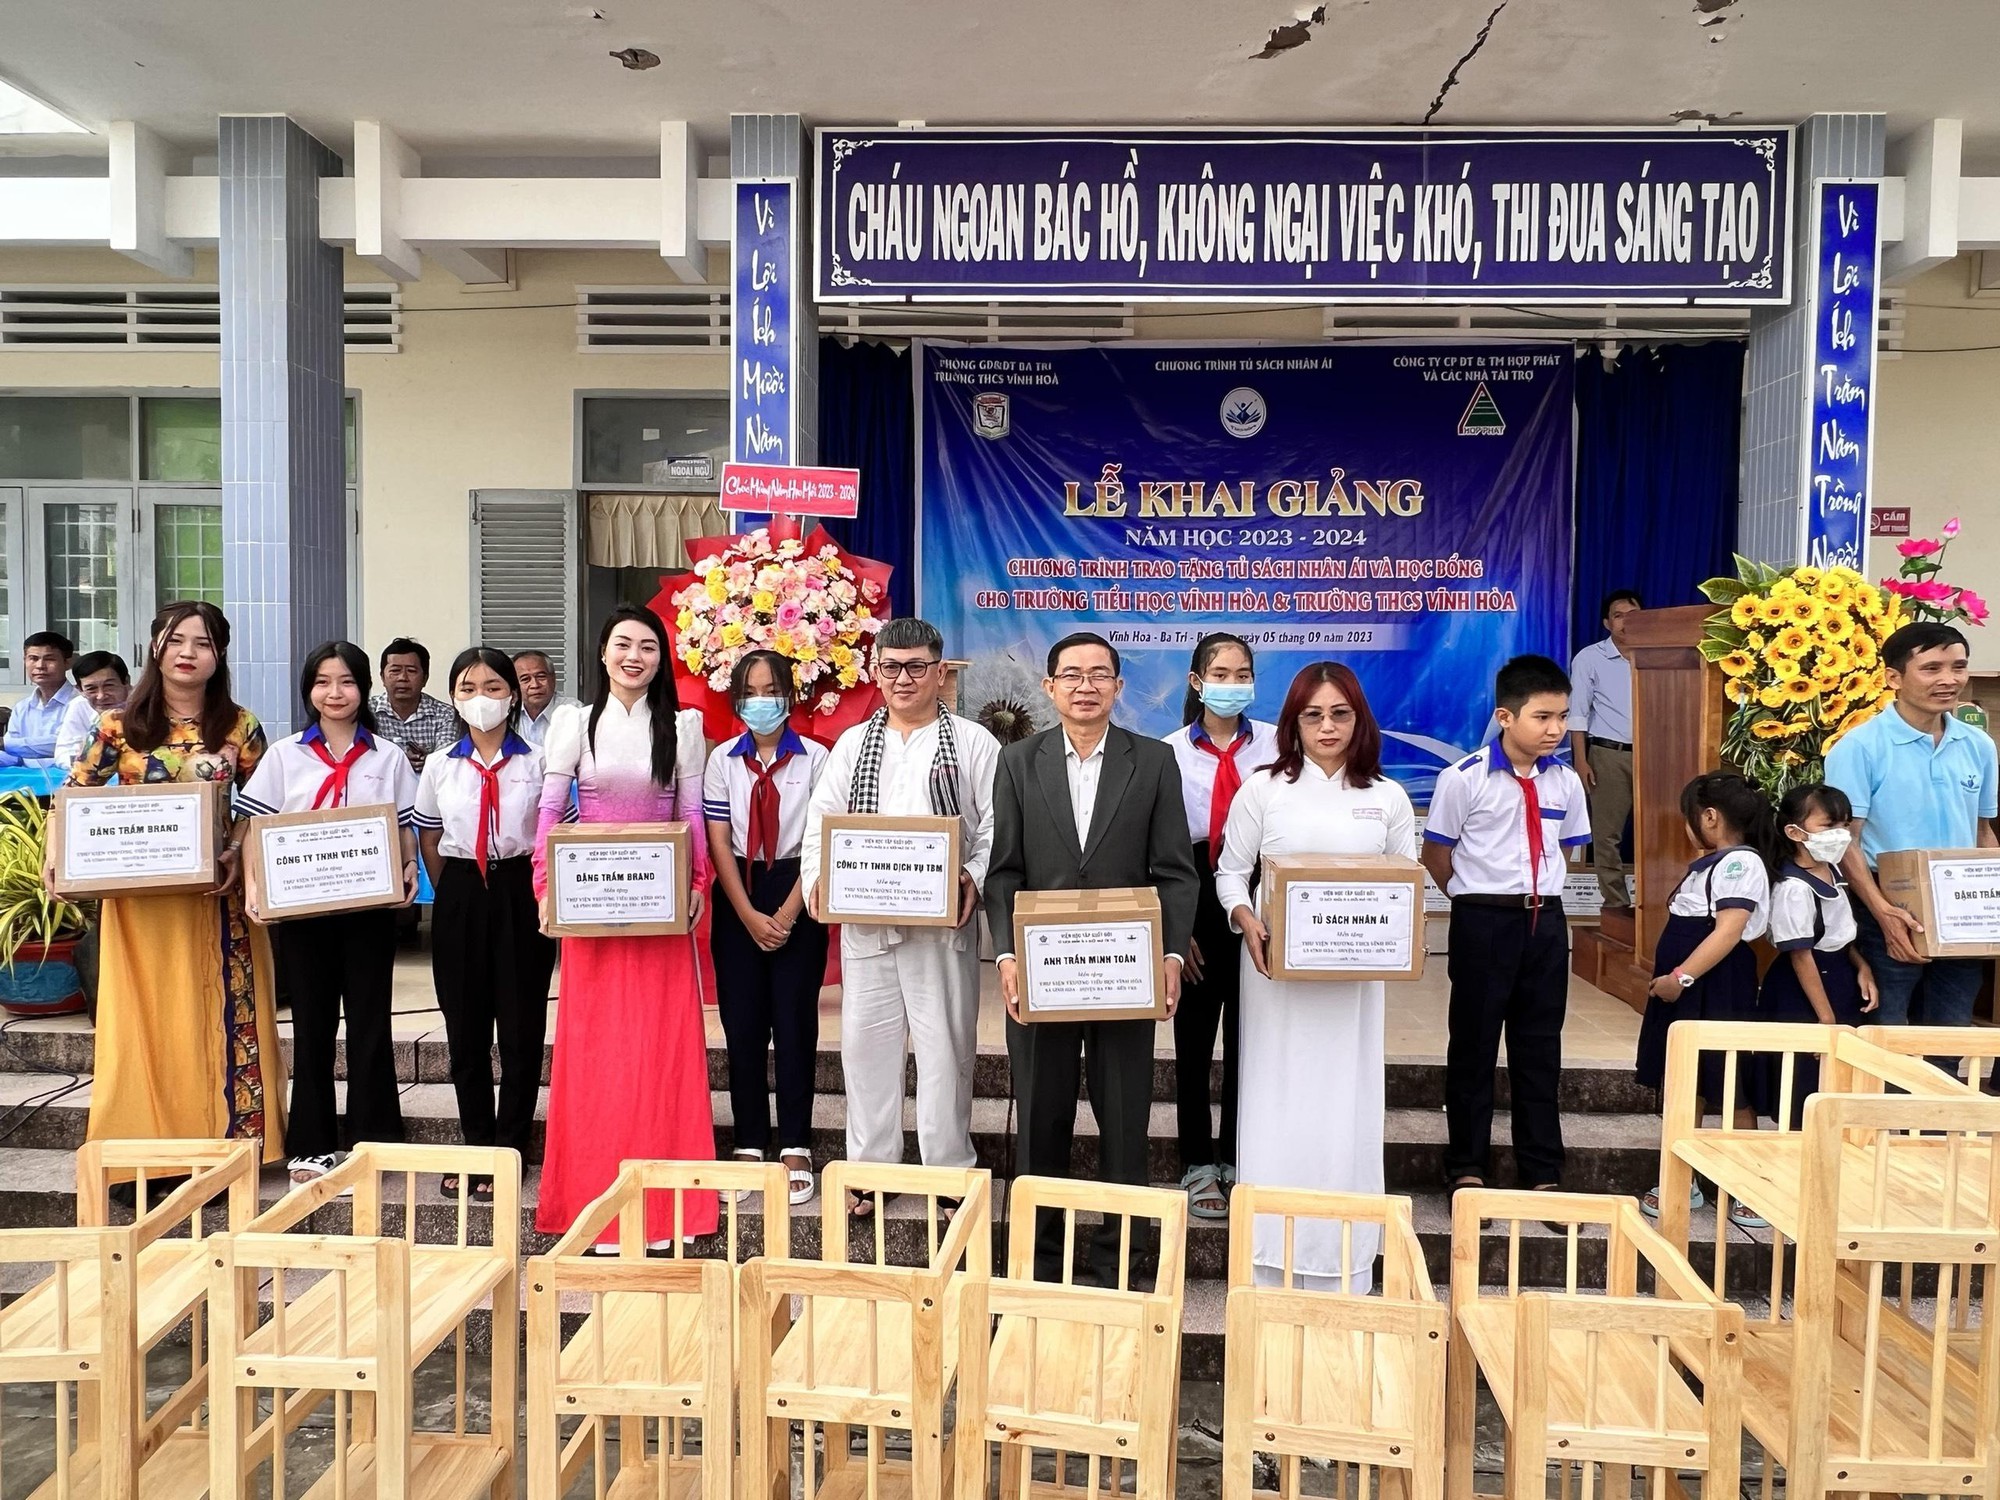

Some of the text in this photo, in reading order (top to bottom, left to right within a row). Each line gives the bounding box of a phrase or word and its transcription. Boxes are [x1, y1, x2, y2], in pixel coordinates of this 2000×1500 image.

[848, 148, 1758, 280] CHÁU NGOAN BÁC HỒ, KHÔNG NGẠI VIỆC KHÓ, THI ĐUA SÁNG TẠO
[1839, 195, 1859, 238] Vì
[1833, 252, 1859, 295] Lợi
[743, 193, 785, 460] Vì Lợi Ích Mười Năm
[1832, 301, 1856, 350] Ích
[940, 358, 976, 369] PHÒNG
[1036, 362, 1051, 371] TRI
[1155, 357, 1332, 371] CHƯƠNG TRÌNH TỦ SÁCH NHÂN ÁI
[1393, 356, 1425, 367] CÔNG
[1428, 357, 1441, 367] TY
[1444, 357, 1457, 367] CP
[1477, 357, 1485, 366] &
[1489, 356, 1504, 366] TM
[1507, 356, 1530, 368] HỢP
[1533, 354, 1560, 366] PHÁT
[978, 374, 1004, 384] THCS
[1007, 373, 1032, 385] VĨNH
[1423, 369, 1533, 382] VÀ CÁC NHÀ TÀI TRỢ
[1821, 364, 1865, 412] Trăm
[1820, 419, 1859, 466] Năm
[818, 483, 834, 499] 2023
[840, 484, 856, 500] 2024
[1063, 463, 1424, 518] LỄ KHAI GIẢNG
[1814, 475, 1862, 552] Trồng
[1125, 526, 1176, 547] NĂM
[1183, 529, 1232, 550] HỌC
[1239, 530, 1292, 546] 2023
[1313, 529, 1367, 546] 2024
[1007, 552, 1483, 581] CHƯƠNG TRÌNH TRAO TẶNG TỦ SÁCH NHÂN ÁI VÀ HỌC BỔNG
[975, 584, 1517, 615] CHO TRƯỜNG TIỂU HỌC VĨNH HÒA & TRƯỜNG THCS VĨNH HÒA
[1109, 631, 1129, 642] Vĩnh
[1160, 632, 1171, 642] Ba
[1176, 632, 1187, 642] Tri
[1263, 632, 1275, 642] 05
[1279, 632, 1304, 645] tháng
[1308, 632, 1320, 642] 09
[1324, 633, 1343, 642] năm
[1347, 632, 1372, 642] 2023
[148, 824, 179, 833] BRAND
[277, 846, 378, 865] CÔNG TY TNHH VIỆT NGÔ
[836, 860, 857, 869] CÔNG
[893, 863, 911, 872] DỊCH
[914, 864, 924, 873] VỤ
[927, 864, 942, 872] TBM
[1312, 913, 1388, 924] TỦ SÁCH NHÂN ÁI
[1044, 957, 1061, 965] ANH
[1089, 956, 1111, 964] MINH
